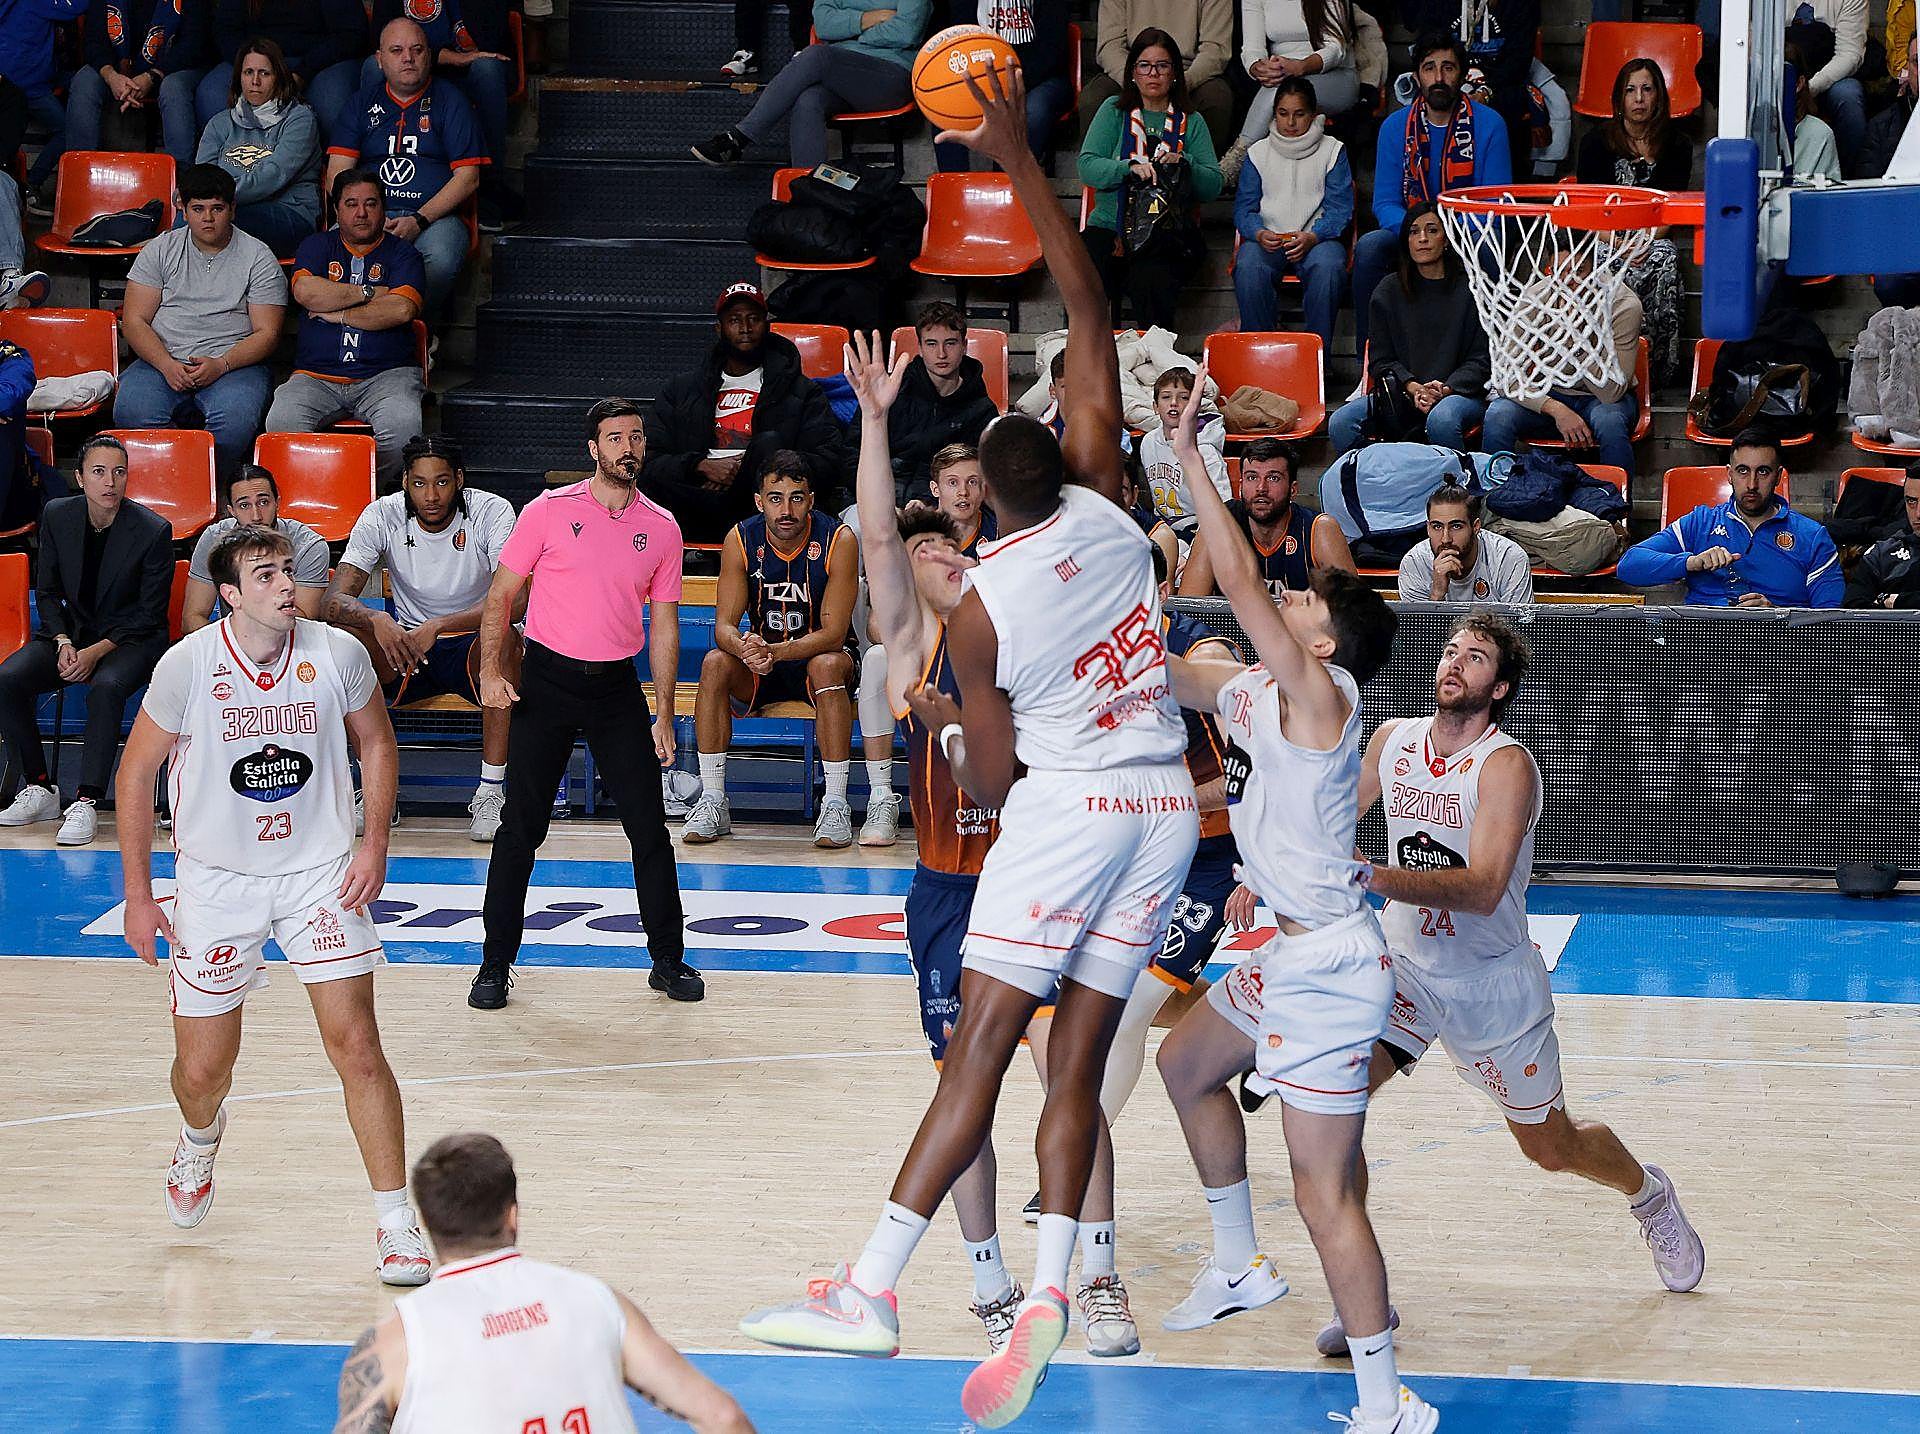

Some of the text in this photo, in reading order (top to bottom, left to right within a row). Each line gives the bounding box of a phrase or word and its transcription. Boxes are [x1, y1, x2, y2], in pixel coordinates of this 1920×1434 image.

[988, 6, 1019, 19] JACK
[988, 18, 1032, 30] JONES
[390, 189, 423, 199] Motor
[719, 392, 755, 408] NIKE
[1153, 486, 1184, 516] 24
[1054, 555, 1083, 583] GILL
[763, 582, 809, 603] TZN
[766, 609, 804, 632] 60
[1073, 602, 1166, 692] 35
[222, 701, 318, 742] 32005
[242, 757, 301, 776] Estrella
[244, 772, 299, 790] Galicia
[1389, 781, 1464, 830] 32005
[256, 811, 292, 842] 23
[1402, 844, 1451, 868] Estrella
[1418, 907, 1456, 937] 24
